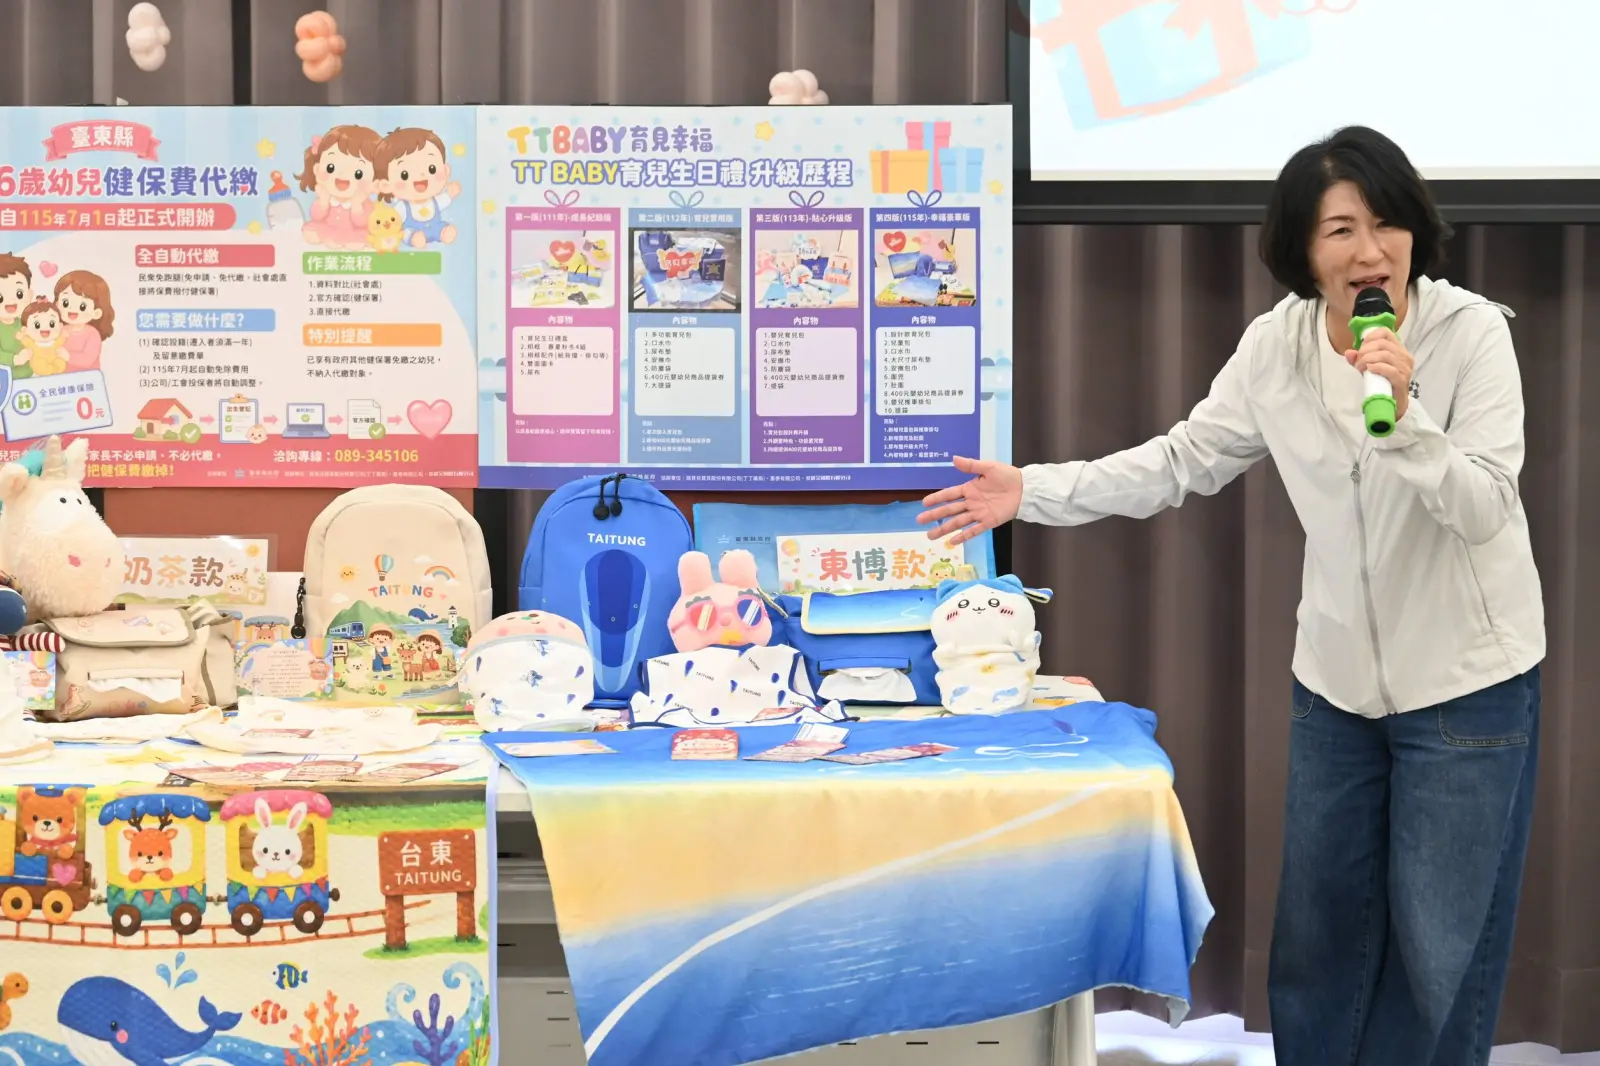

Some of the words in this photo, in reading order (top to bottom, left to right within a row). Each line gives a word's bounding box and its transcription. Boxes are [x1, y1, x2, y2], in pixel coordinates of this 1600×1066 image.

[70, 125, 134, 149] 臺東縣
[511, 159, 548, 185] TT
[551, 157, 746, 188] BABY育兒生日禮
[749, 157, 853, 189] 升級歷程
[1, 208, 215, 228] 自115年7月1日起正式開辦
[139, 248, 220, 264] 全自動代繳
[307, 255, 373, 272] 作業流程
[309, 294, 382, 303] 2.官方確認(健保署)
[309, 308, 351, 316] 3.直接代繳
[548, 315, 574, 325] 內容物
[911, 315, 936, 325] 內容物
[672, 316, 698, 325] 內容物
[793, 316, 819, 326] 內容物
[307, 328, 373, 344] 特別提醒
[587, 532, 646, 547] TAITUNG
[123, 555, 224, 588] 奶茶款
[818, 548, 927, 582] 東博款
[368, 584, 434, 598] TAITUNG
[742, 687, 762, 698] TAITUNG
[400, 838, 453, 868] 台東
[394, 869, 462, 886] TAITUNG
